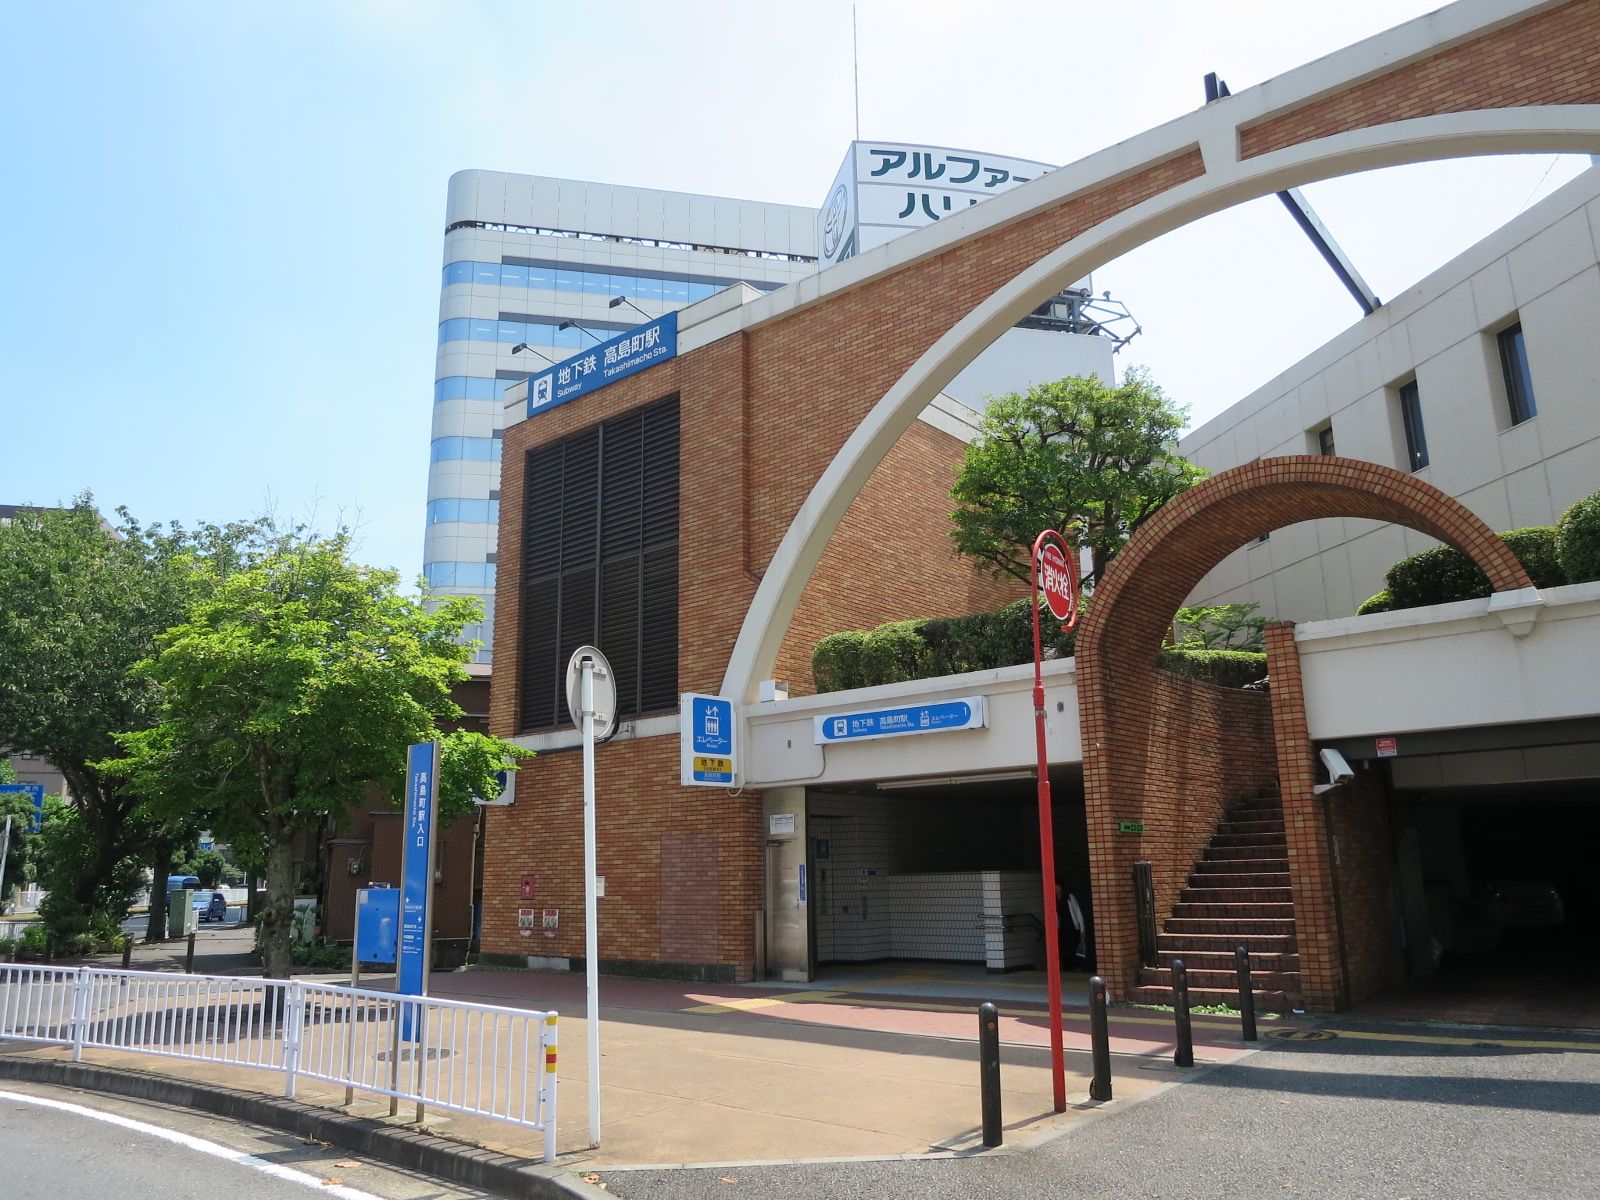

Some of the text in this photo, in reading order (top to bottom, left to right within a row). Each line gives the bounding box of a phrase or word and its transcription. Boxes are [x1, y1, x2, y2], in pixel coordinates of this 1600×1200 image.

[869, 149, 1048, 188] アルファー
[557, 345, 668, 397] Subway Takashimacho Sta.
[558, 326, 660, 384] 地下鉄 高島町駅
[1044, 562, 1069, 600] 消火栓
[852, 706, 968, 728] 地下鉄 高島町駅 エレベーター 1
[697, 735, 728, 745] エレベーター
[416, 772, 428, 847] 高島町駅入口
